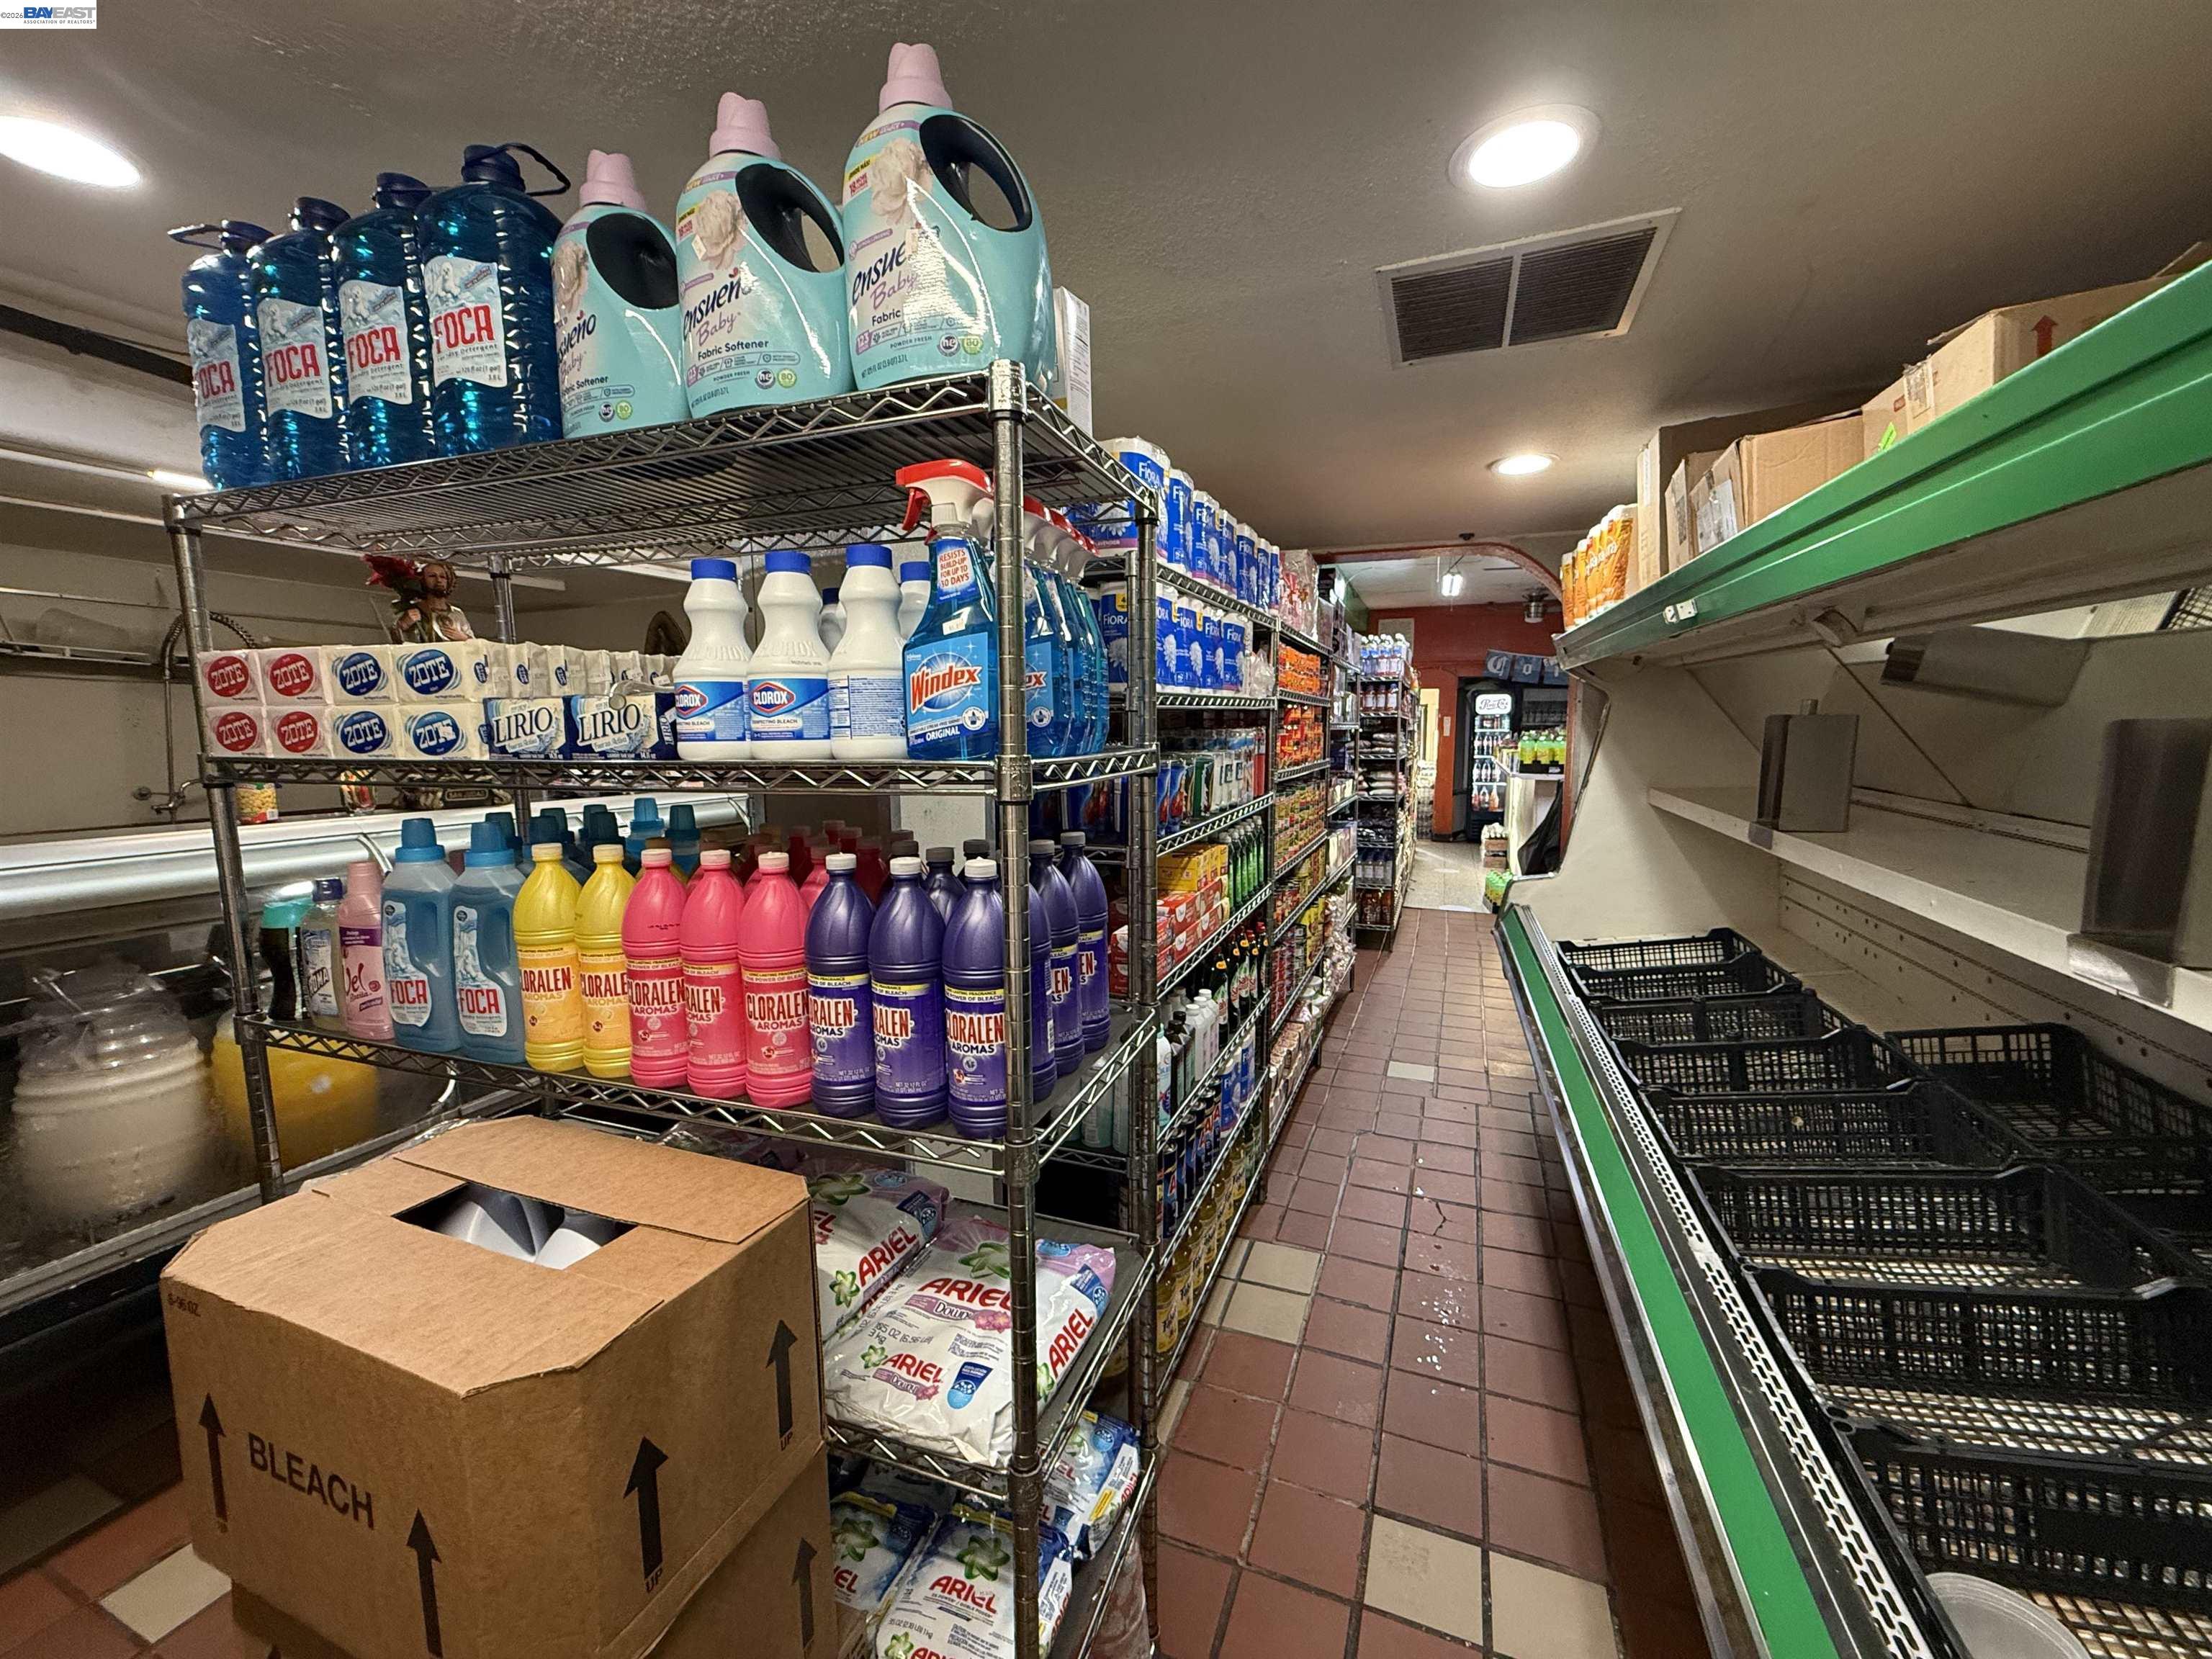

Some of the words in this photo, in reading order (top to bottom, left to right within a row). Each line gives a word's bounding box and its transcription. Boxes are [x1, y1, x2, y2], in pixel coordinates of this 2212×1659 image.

[433, 305, 495, 354] FOCA
[696, 311, 739, 347] Baby
[872, 309, 901, 326] Fabric
[559, 310, 597, 360] sueño
[890, 338, 913, 349] POWDER
[346, 326, 401, 373] FOCA
[461, 343, 498, 356] Detergent
[698, 346, 722, 361] Fabric
[725, 340, 770, 353] Softener
[264, 343, 321, 387] FOCA
[197, 360, 235, 400] OCA
[576, 376, 609, 390] Softener
[940, 549, 966, 562] RESISTS
[940, 557, 967, 571] BUILD-UP
[950, 573, 970, 585] DAYS
[951, 567, 960, 575] UP
[960, 565, 968, 573] TO
[211, 663, 246, 690] ZOTE
[273, 661, 311, 690] ZOTE
[342, 660, 379, 690] ZOTE
[408, 658, 450, 689] ZOTE
[753, 691, 788, 706] CLOROX
[911, 665, 979, 713] Windex
[218, 719, 253, 746] ZOTE
[281, 719, 315, 745] ZOTE
[343, 719, 382, 747] ZOTE
[494, 707, 553, 745] LIRIO
[579, 703, 641, 744] LIRIO
[661, 715, 675, 746] LIRIO
[926, 726, 961, 742] ORIGINAL
[342, 962, 367, 997] Vel
[390, 979, 428, 1004] FOCA
[580, 972, 628, 998] CLORALE
[459, 988, 500, 1015] FOCA
[634, 1004, 678, 1015] AROMAS
[685, 985, 721, 1013] RALEN
[688, 1012, 712, 1022] OMAS
[757, 1019, 802, 1030] AROMAS
[811, 1027, 843, 1036] ROMAS
[874, 1035, 900, 1047] OMAS
[952, 1043, 995, 1054] AROMAS
[859, 1226, 917, 1287] ARIEL
[875, 1331, 887, 1346] kg
[888, 1326, 902, 1340] OZ
[900, 1333, 920, 1344] (6.56
[1048, 1308, 1095, 1378] ARIEL
[882, 1353, 944, 1384] ARIEL
[780, 1431, 793, 1452] UP
[248, 1431, 374, 1531] BLEACH
[645, 1568, 662, 1593] UP
[929, 1575, 997, 1615] ARIEL
